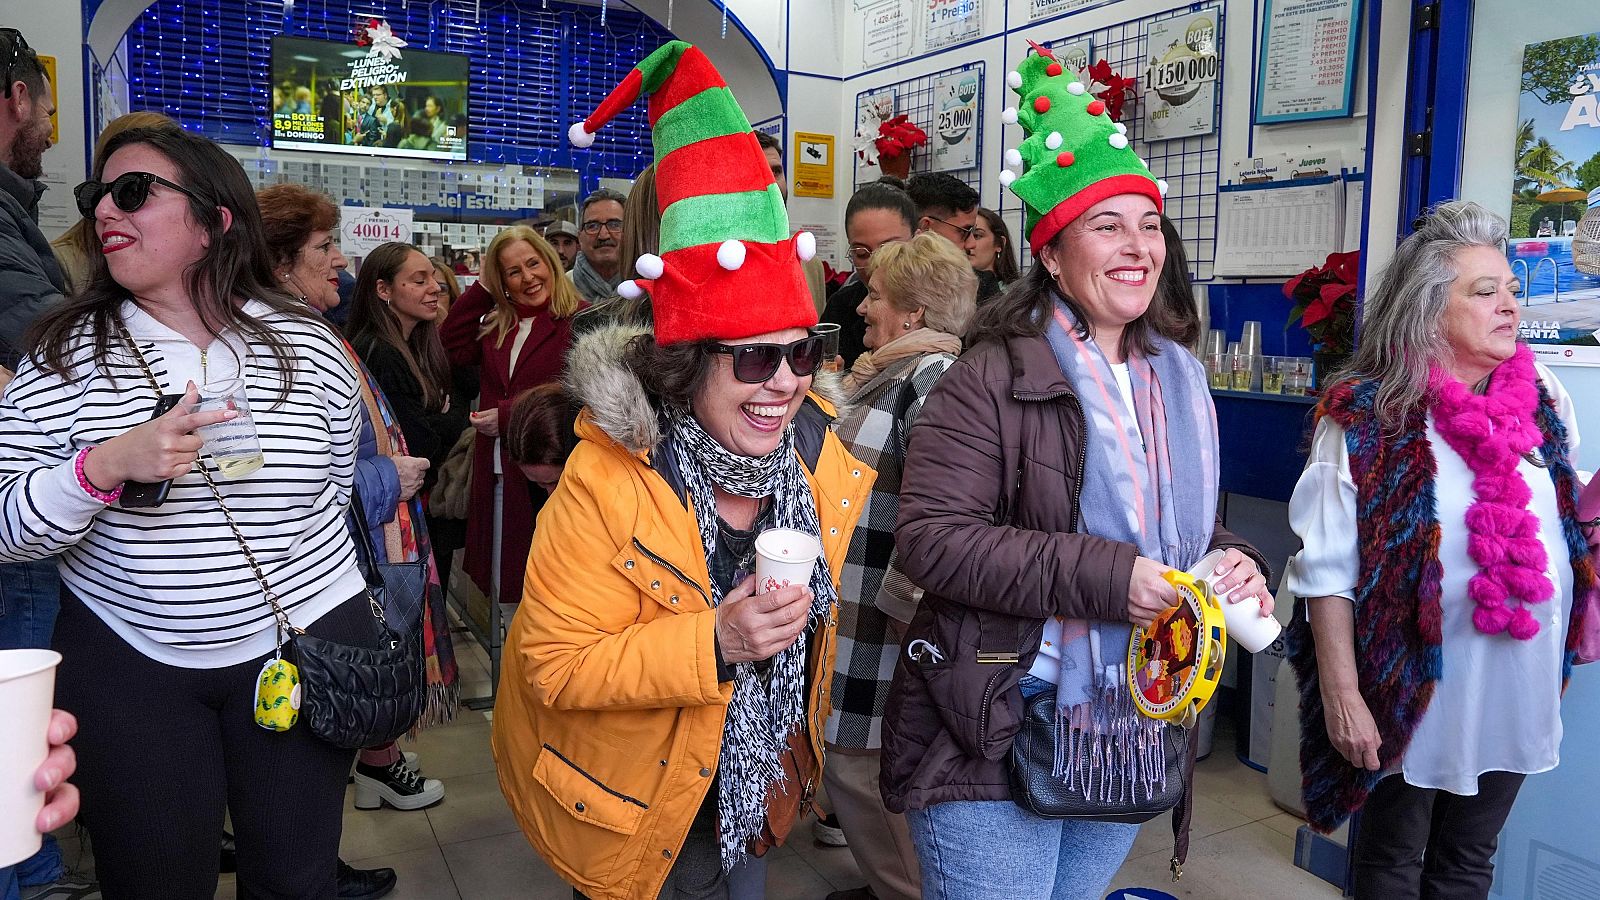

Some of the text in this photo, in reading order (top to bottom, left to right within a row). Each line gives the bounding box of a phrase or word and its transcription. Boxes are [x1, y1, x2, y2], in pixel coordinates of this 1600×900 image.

[1300, 2, 1348, 14] ESTABLECIMIENTO
[1323, 20, 1349, 28] PREMIO
[1321, 42, 1346, 50] PREMIO
[1320, 49, 1346, 57] PREMIO
[353, 57, 386, 69] LUNES
[1578, 62, 1600, 72] TAM
[351, 64, 394, 79] PELIGRO
[1318, 71, 1344, 79] PREMIO
[340, 71, 408, 91] EXTINCIÓN
[957, 82, 977, 97] BOTE
[291, 112, 317, 122] BOTE
[1152, 110, 1170, 120] BOTE
[1559, 94, 1600, 132] A
[274, 119, 292, 131] 8,9
[286, 131, 325, 140] DOMINGO
[1299, 157, 1326, 168] Jueves
[1240, 166, 1278, 177] Lotería Nacional
[437, 192, 462, 209] del
[352, 223, 400, 239] 40014
[1542, 320, 1561, 330] LA
